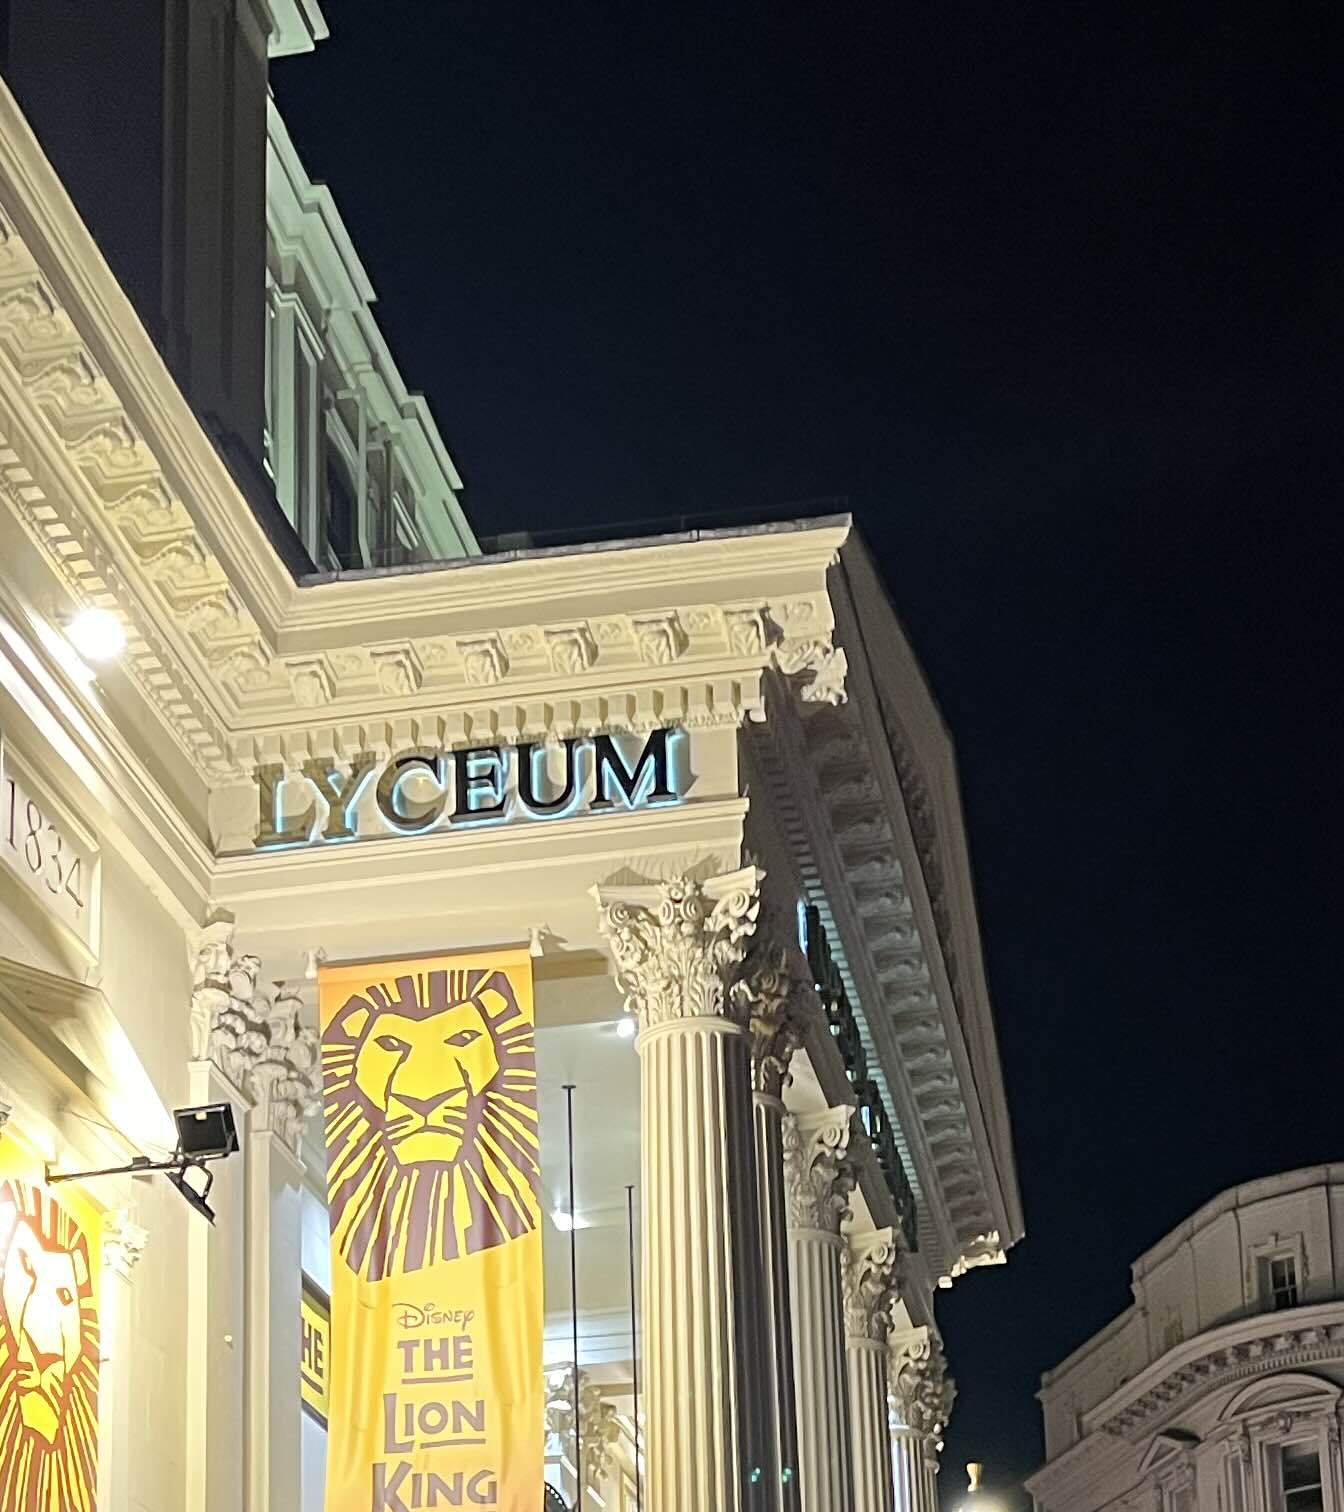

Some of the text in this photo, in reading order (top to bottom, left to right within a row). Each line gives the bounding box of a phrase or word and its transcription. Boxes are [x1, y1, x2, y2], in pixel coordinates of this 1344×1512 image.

[257, 728, 684, 850] LYCEUM
[3, 779, 85, 910] 1834
[301, 1317, 324, 1379] HE
[397, 1335, 474, 1374] THE
